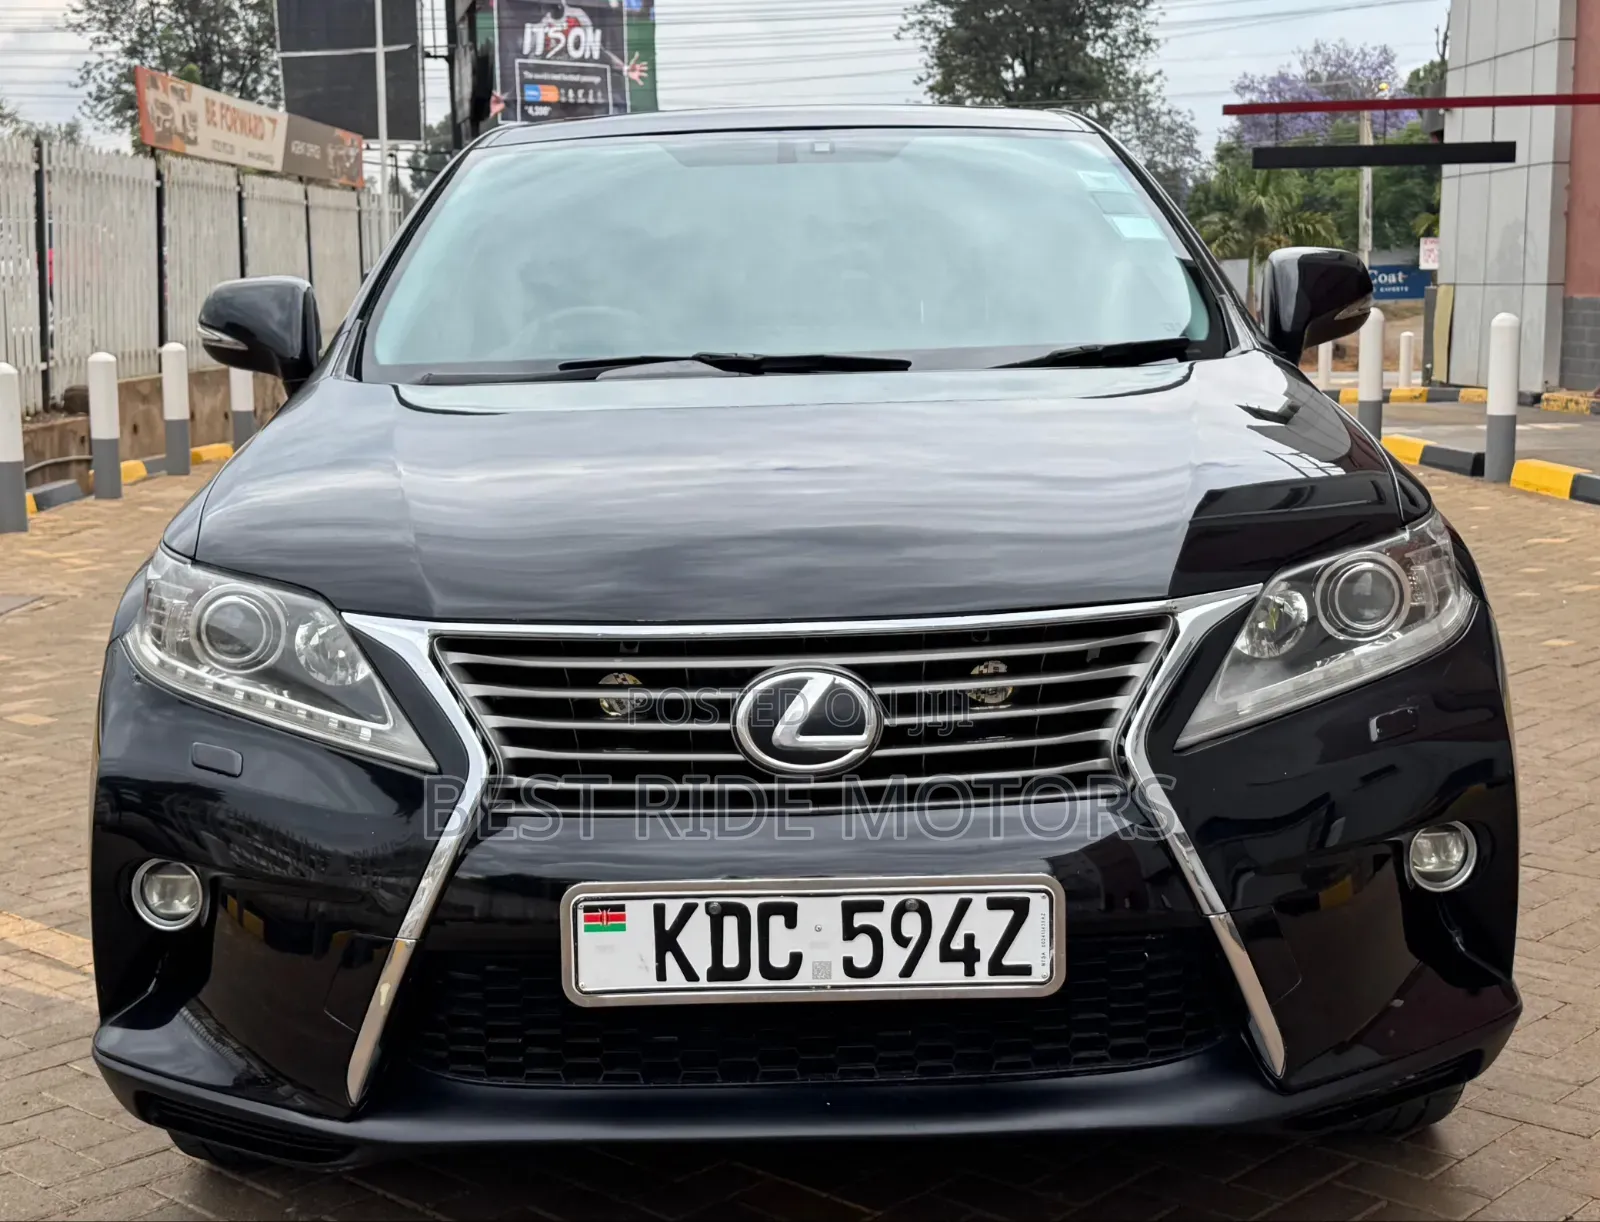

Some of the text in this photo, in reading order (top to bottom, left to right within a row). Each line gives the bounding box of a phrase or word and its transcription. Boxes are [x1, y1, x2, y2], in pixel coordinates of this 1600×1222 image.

[567, 27, 602, 60] ON
[204, 97, 266, 141] BE FORWARD
[652, 896, 1033, 982] KDC 594Z
